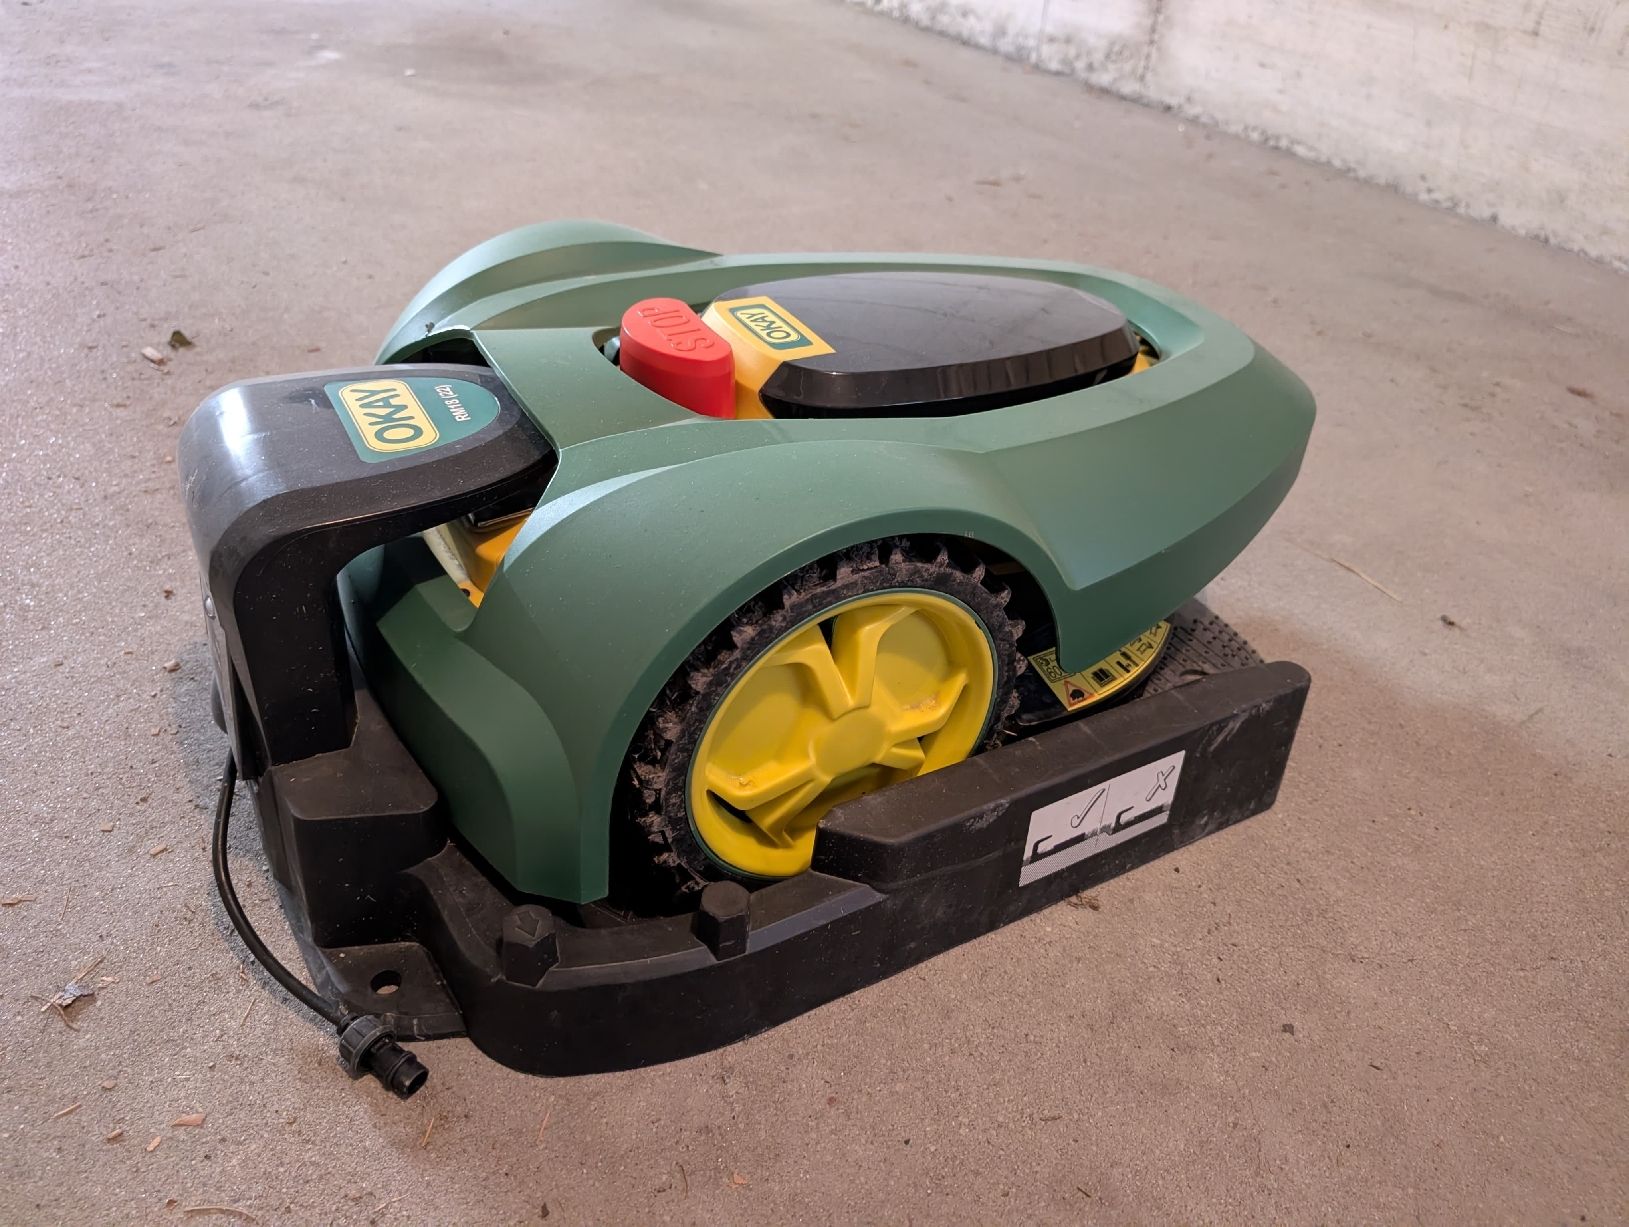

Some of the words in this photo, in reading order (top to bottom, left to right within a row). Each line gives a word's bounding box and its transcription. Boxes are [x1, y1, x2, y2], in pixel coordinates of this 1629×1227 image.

[636, 308, 715, 352] STOP
[741, 311, 791, 340] OKAY
[434, 384, 458, 399] (22)
[350, 388, 424, 444] OKAY
[445, 399, 471, 421] RM18
